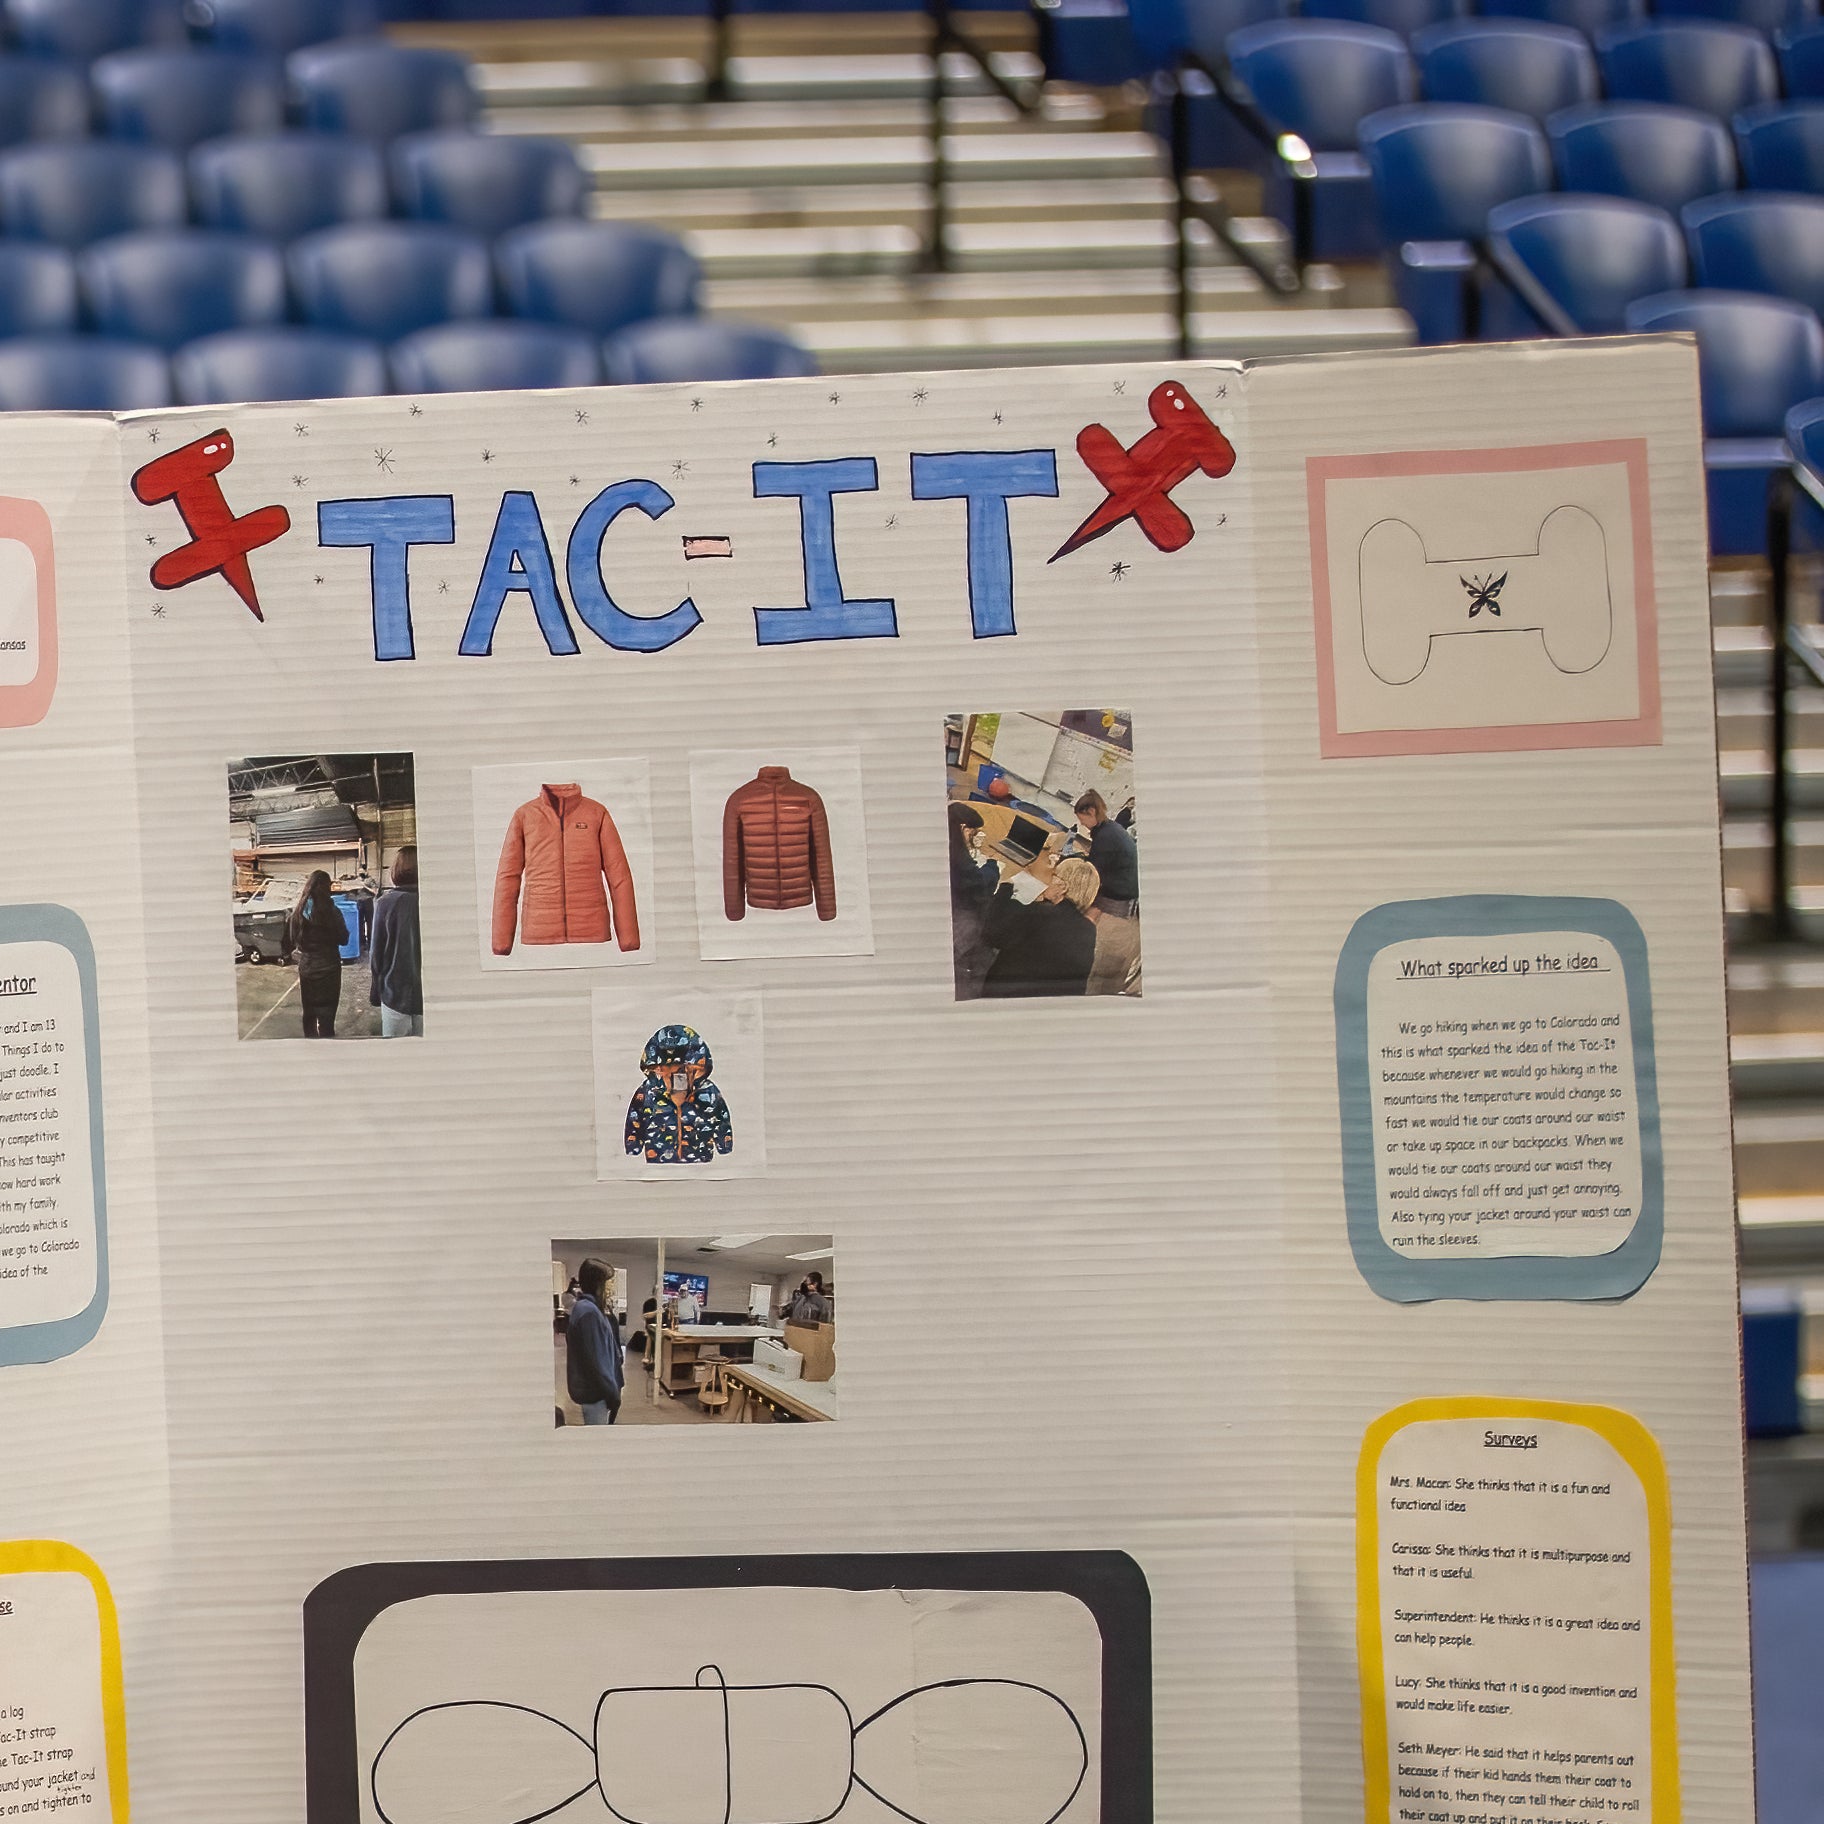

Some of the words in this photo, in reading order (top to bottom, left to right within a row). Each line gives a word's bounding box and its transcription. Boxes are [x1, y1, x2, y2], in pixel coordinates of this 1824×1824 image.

[317, 448, 1058, 661] TAC-IT
[1400, 959, 1442, 976] What
[1447, 955, 1507, 975] sparked
[1512, 959, 1530, 973] up
[1535, 954, 1562, 971] the
[1566, 953, 1598, 969] idea
[3, 1021, 20, 1034] and
[30, 1022, 43, 1032] am
[45, 1018, 55, 1030] 13
[1398, 1021, 1417, 1034] We
[1419, 1024, 1432, 1037] go
[1435, 1020, 1467, 1036] hiking
[1470, 1018, 1498, 1031] when
[1500, 1020, 1516, 1030] we
[1518, 1020, 1531, 1033] go
[1534, 1016, 1547, 1029] to
[1549, 1013, 1597, 1028] Colorado
[1600, 1012, 1620, 1027] and
[1484, 1430, 1538, 1450] Surveys
[1454, 1477, 1475, 1490] She
[1477, 1478, 1510, 1491] thinks
[1512, 1479, 1535, 1492] that
[1538, 1481, 1547, 1492] it
[1550, 1483, 1559, 1493] is
[1570, 1481, 1589, 1493] fun
[1590, 1483, 1610, 1494] and
[1390, 1496, 1441, 1511] functional
[1443, 1499, 1466, 1512] idea
[9, 1704, 24, 1720] log
[29, 1726, 56, 1739] strap
[10, 1750, 43, 1765] Tac-It
[46, 1748, 73, 1761] strap
[20, 1776, 44, 1792] your
[46, 1769, 80, 1788] jacket
